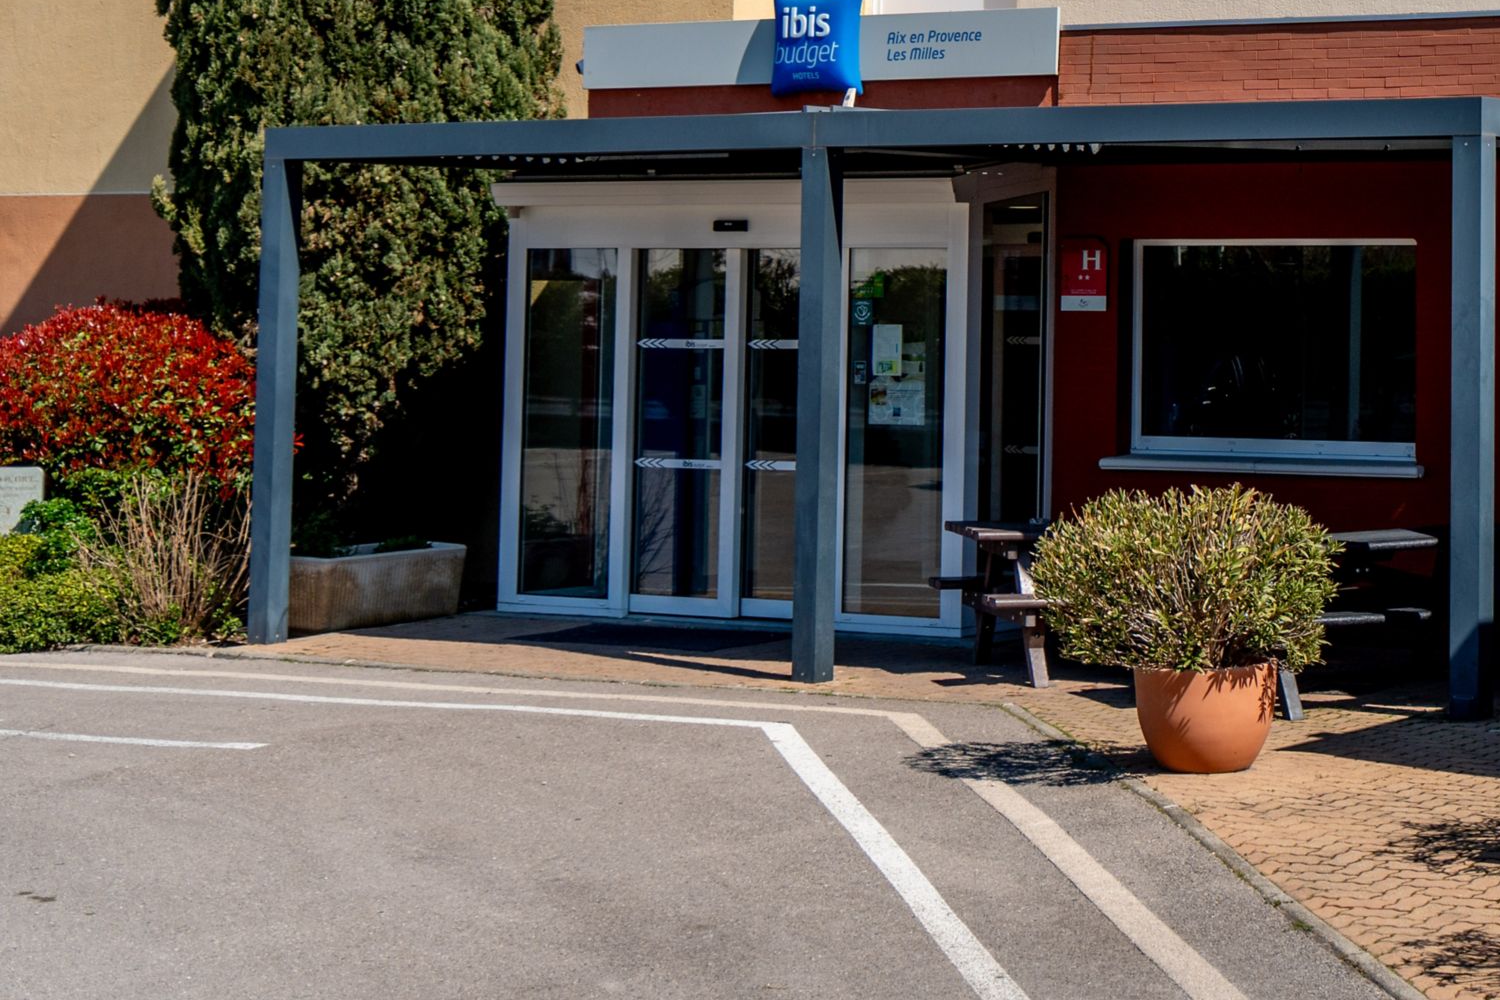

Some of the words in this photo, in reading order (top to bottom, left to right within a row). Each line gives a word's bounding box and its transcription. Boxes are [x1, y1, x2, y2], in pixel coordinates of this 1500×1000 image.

[782, 5, 831, 38] ibis
[887, 31, 906, 44] Aix
[909, 32, 924, 44] en
[928, 30, 982, 43] Provence
[775, 40, 839, 68] budget
[887, 48, 906, 62] Les
[909, 46, 945, 60] Milles
[792, 71, 820, 81] HOTELS
[1081, 249, 1102, 271] H
